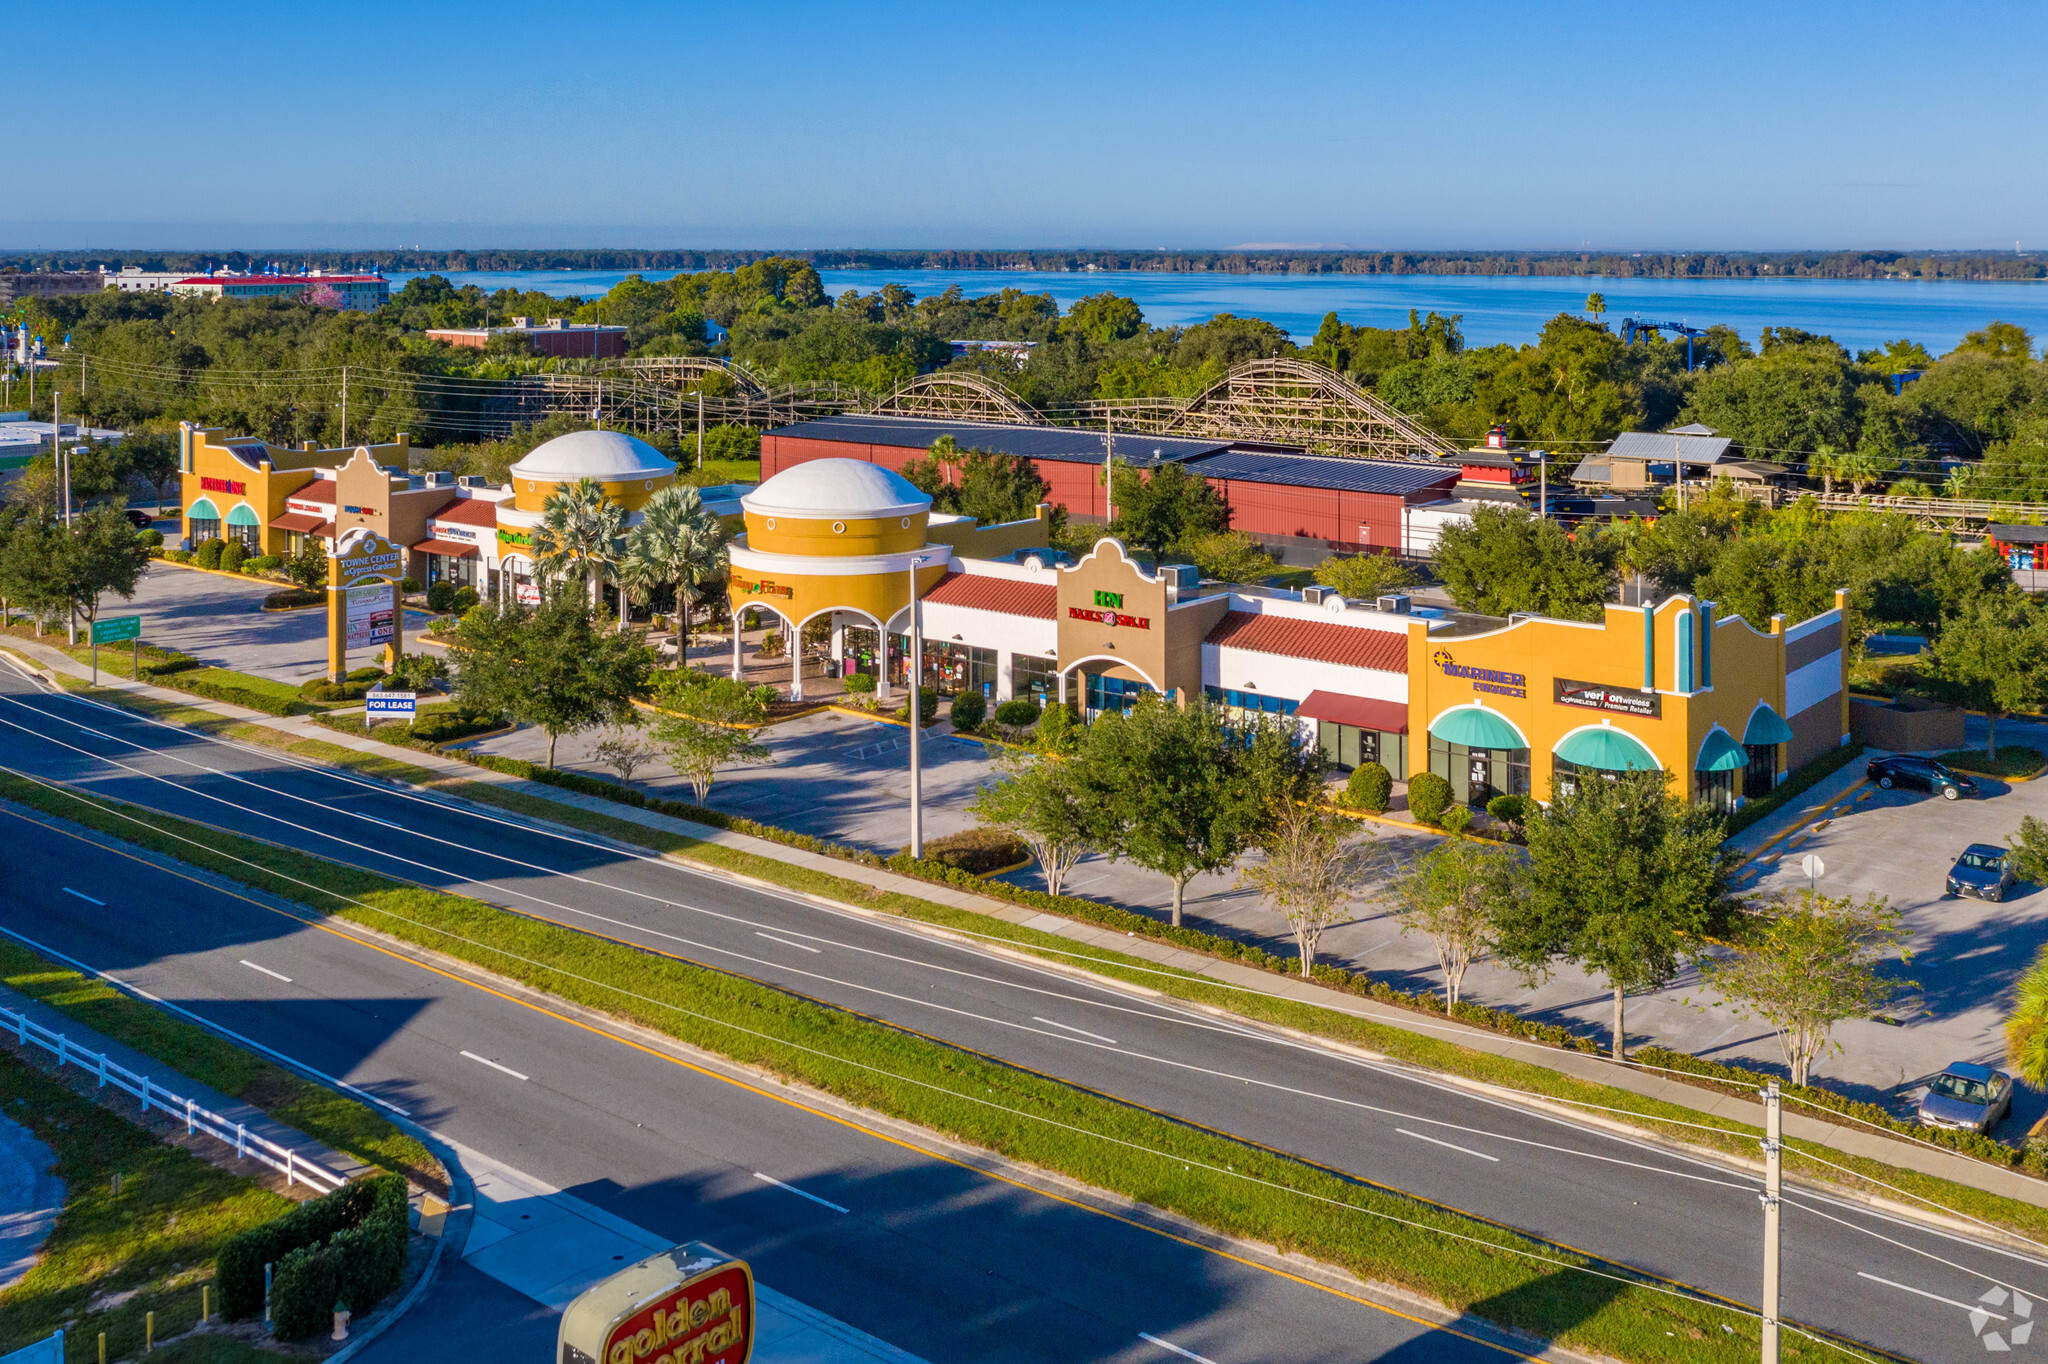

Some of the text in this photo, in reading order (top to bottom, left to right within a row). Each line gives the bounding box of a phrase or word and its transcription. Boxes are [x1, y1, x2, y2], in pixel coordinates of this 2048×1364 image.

[341, 552, 400, 569] TOWNE CENTER
[349, 565, 372, 576] Cypress
[372, 562, 397, 571] Gardens
[1093, 590, 1122, 609] HN
[1069, 607, 1103, 622] NAILS
[1115, 614, 1136, 628] SPA
[347, 631, 371, 641] MATTRESS
[377, 626, 393, 635] ONE
[1443, 663, 1524, 687] MARINER
[1473, 681, 1525, 698] FINANCE
[369, 701, 413, 709] FOR LEASE
[1604, 701, 1628, 711] Premium
[1629, 705, 1653, 715] Retailer
[609, 1287, 733, 1364] golden
[648, 1303, 743, 1364] rral
